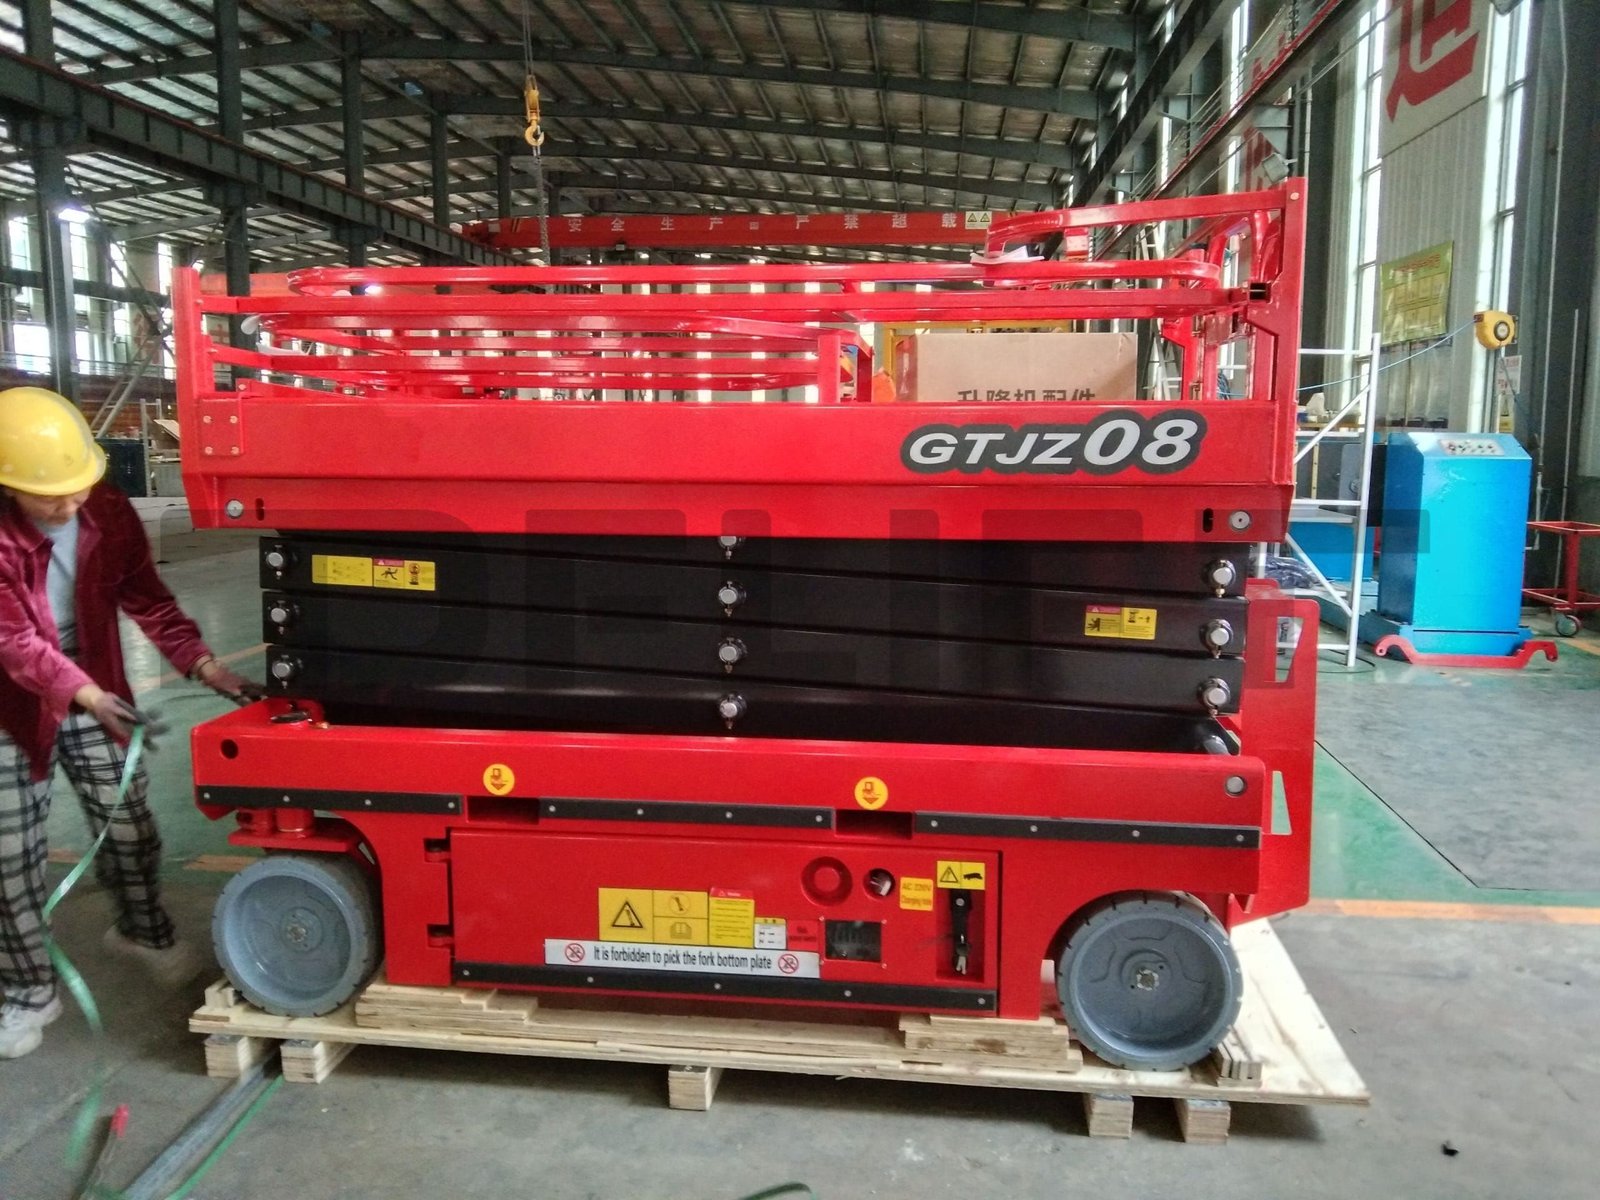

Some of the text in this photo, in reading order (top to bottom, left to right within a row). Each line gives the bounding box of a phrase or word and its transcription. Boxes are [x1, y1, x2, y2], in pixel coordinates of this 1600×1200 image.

[568, 217, 723, 232] 安全生产
[796, 213, 957, 229] 严禁超载
[909, 419, 1198, 465] GTJZ08
[594, 946, 771, 971] It is forbidden to pick the fork bottom plate
